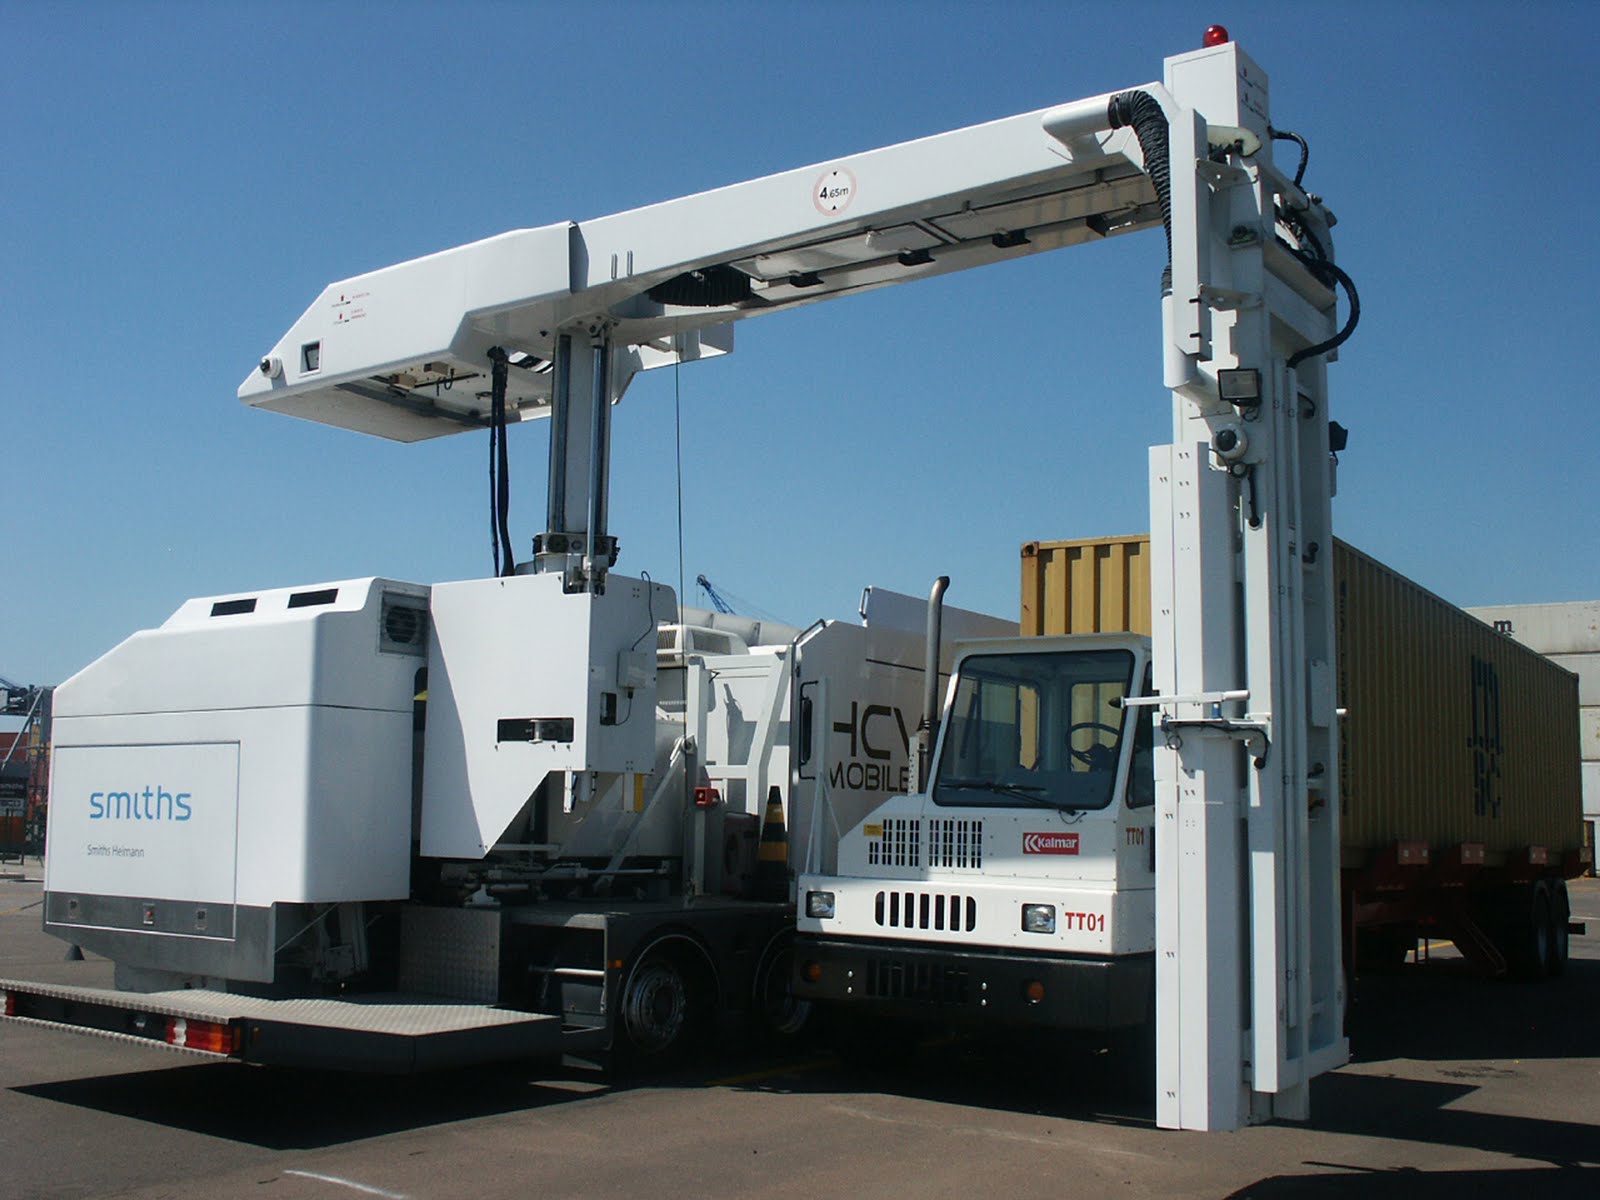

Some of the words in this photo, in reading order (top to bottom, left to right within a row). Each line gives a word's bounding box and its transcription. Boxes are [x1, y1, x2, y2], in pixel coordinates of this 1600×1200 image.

[829, 761, 909, 792] MOBILE
[89, 785, 192, 821] smiths
[1037, 837, 1078, 849] Kalmar
[1125, 827, 1144, 845] TT01
[87, 844, 111, 856] Smiths
[112, 846, 144, 857] Heimann
[1065, 911, 1105, 932] TT01
